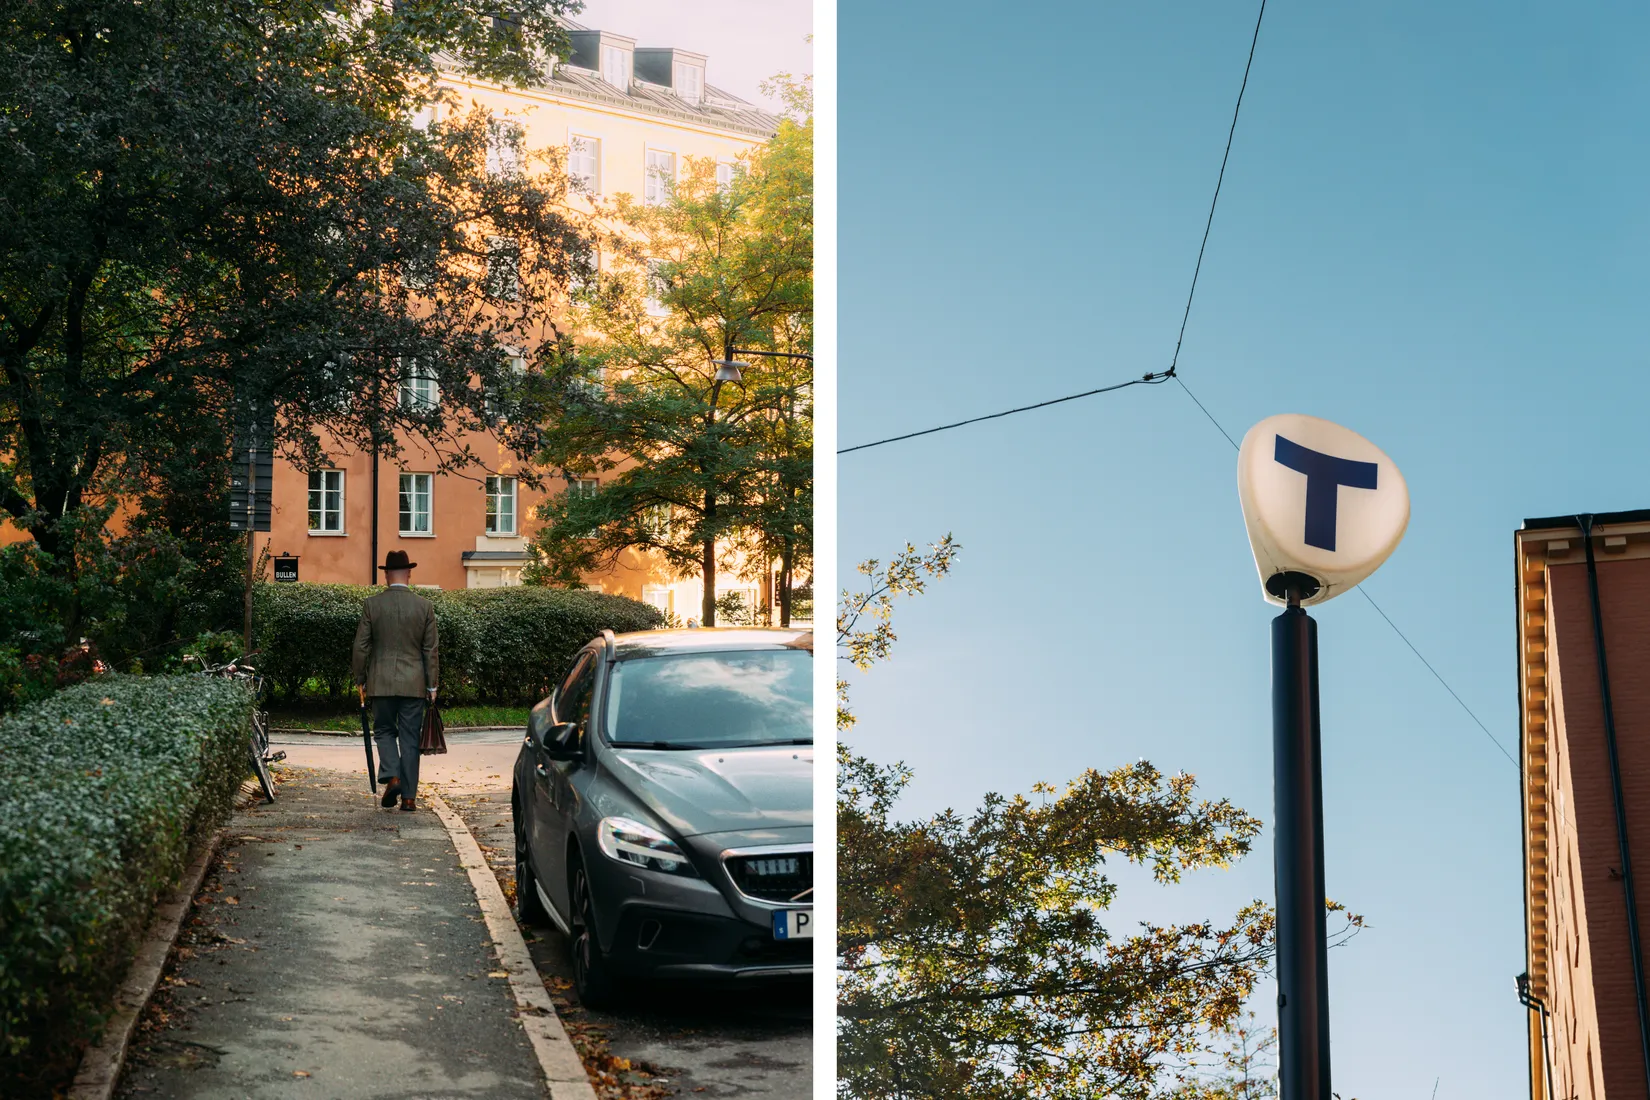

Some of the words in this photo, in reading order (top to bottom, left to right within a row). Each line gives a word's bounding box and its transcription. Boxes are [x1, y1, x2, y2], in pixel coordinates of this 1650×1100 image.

[1274, 434, 1378, 552] T
[276, 571, 297, 579] BULLEN
[796, 912, 809, 935] P
